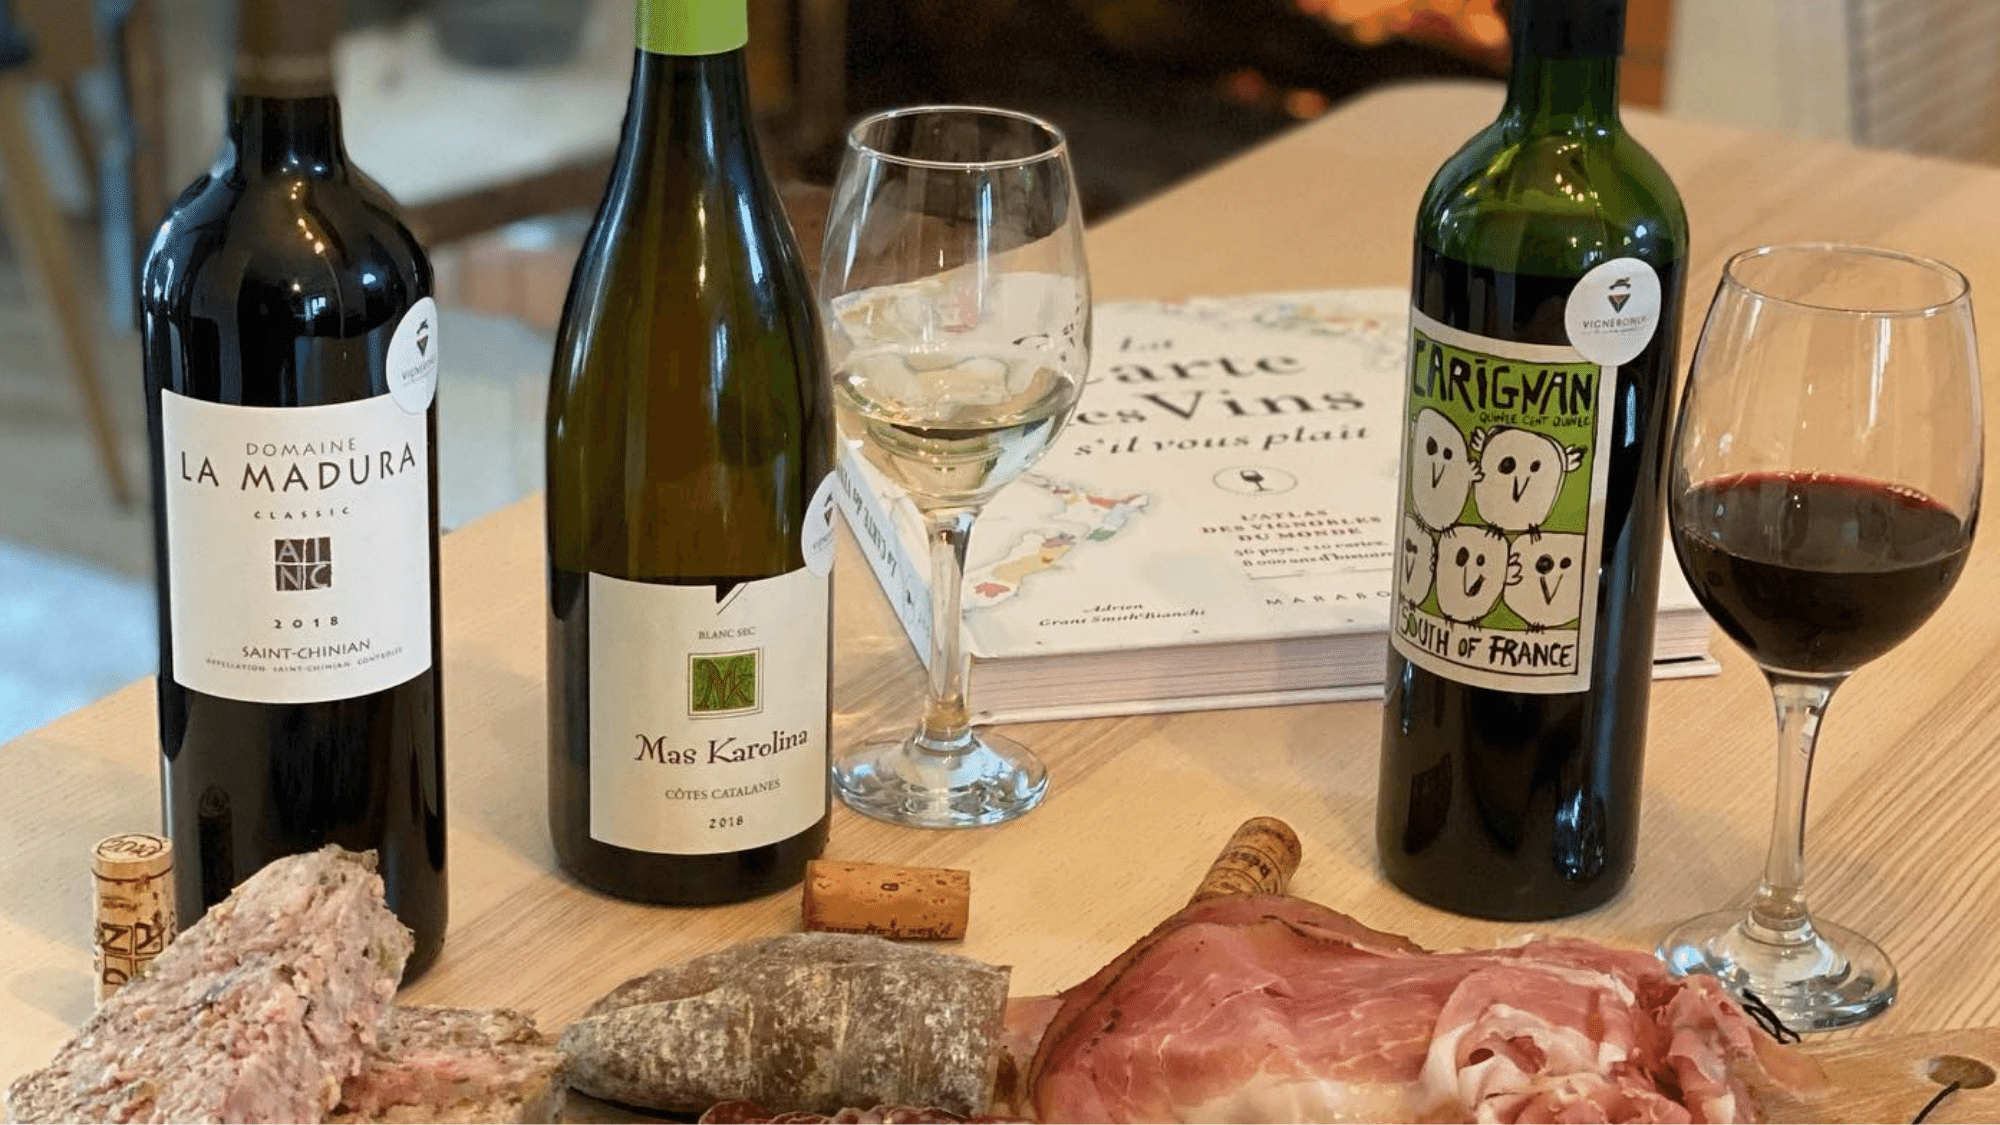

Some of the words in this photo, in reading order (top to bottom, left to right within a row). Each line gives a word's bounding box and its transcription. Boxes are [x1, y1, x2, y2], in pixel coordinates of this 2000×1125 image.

[1109, 357, 1306, 383] arte
[1073, 407, 1147, 425] es
[1132, 390, 1365, 420] Vins
[246, 437, 356, 458] DOMAINE
[1074, 435, 1138, 456] s'il
[1153, 435, 1250, 451] vous
[181, 450, 220, 488] LA
[241, 442, 416, 493] MADURA
[253, 506, 351, 520] CLASSIC
[1241, 510, 1328, 521] L'ATLAS
[1202, 524, 1245, 534] DES
[1250, 515, 1382, 531] VIGNOBLES
[1238, 533, 1270, 542] DU
[1277, 527, 1362, 539] MONDE
[1266, 590, 1391, 606] MARABO
[1083, 603, 1143, 614] Adrien
[273, 615, 339, 629] 2018
[1039, 617, 1087, 627] Grant
[698, 628, 735, 640] BLANC
[737, 626, 756, 638] SEC
[1401, 606, 1450, 657] SOUTH
[1458, 637, 1482, 659] OF
[1489, 634, 1575, 668] FRANCE
[242, 638, 371, 660] SAINT-CHINIAN
[634, 733, 697, 765] Mas
[707, 729, 809, 765] Karolina
[665, 787, 709, 801] CÔTES
[711, 778, 781, 800] CATALANES
[709, 815, 744, 829] 2018
